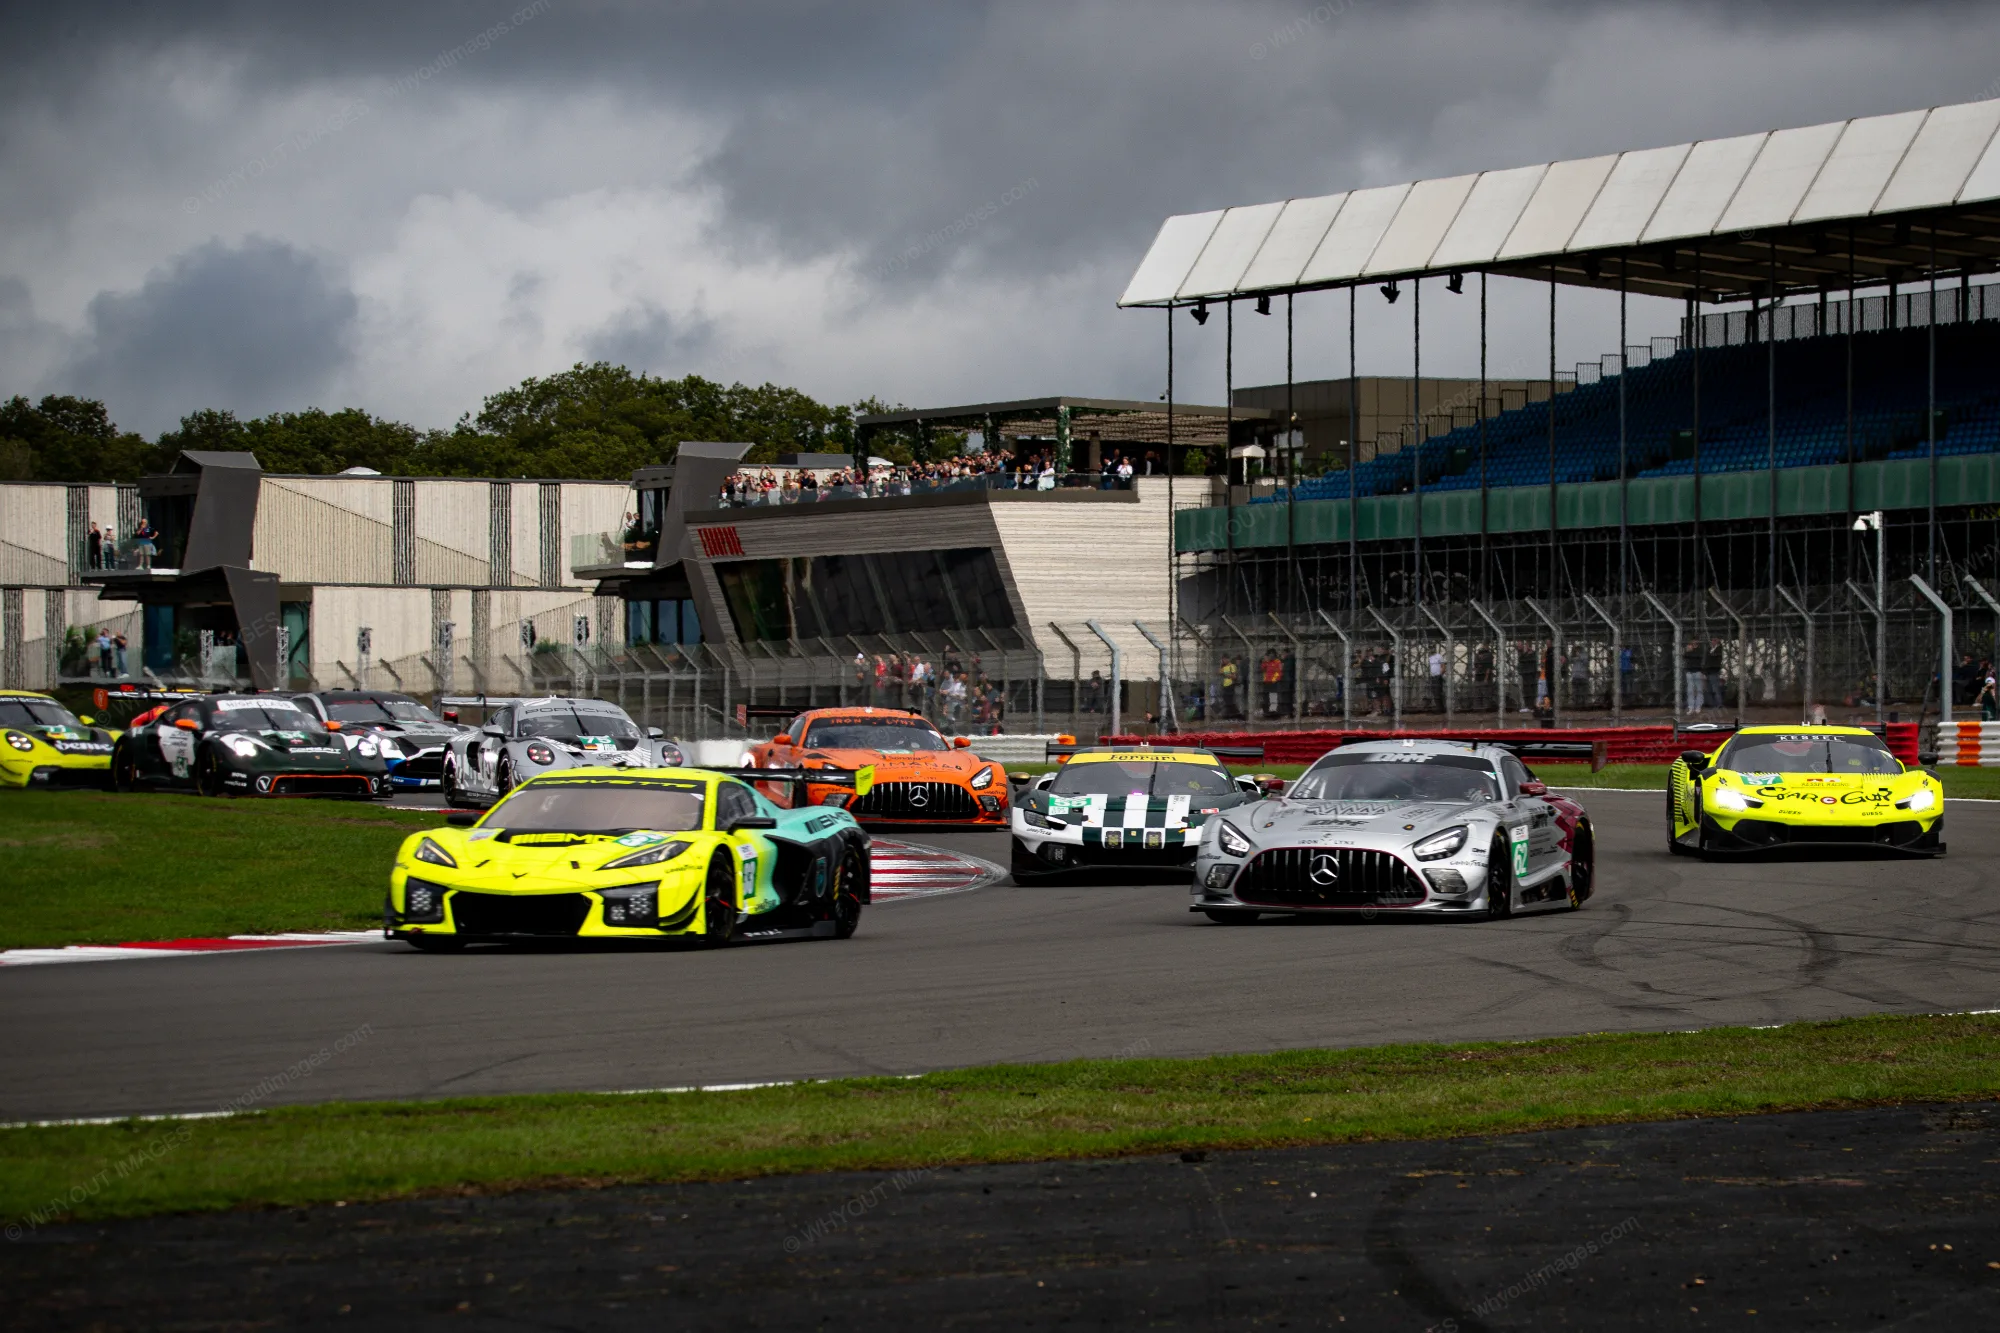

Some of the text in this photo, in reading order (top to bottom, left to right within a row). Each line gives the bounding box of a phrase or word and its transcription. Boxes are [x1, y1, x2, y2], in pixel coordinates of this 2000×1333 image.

[256, 700, 292, 709] CLASS
[525, 707, 622, 716] PORSCHE
[886, 719, 917, 727] LYNX
[586, 735, 612, 744] 75
[1109, 754, 1178, 762] Ferrari
[533, 779, 698, 789] CORVETTE
[1747, 775, 1777, 785] 57
[1054, 797, 1088, 807] 55
[1514, 842, 1529, 876] 62
